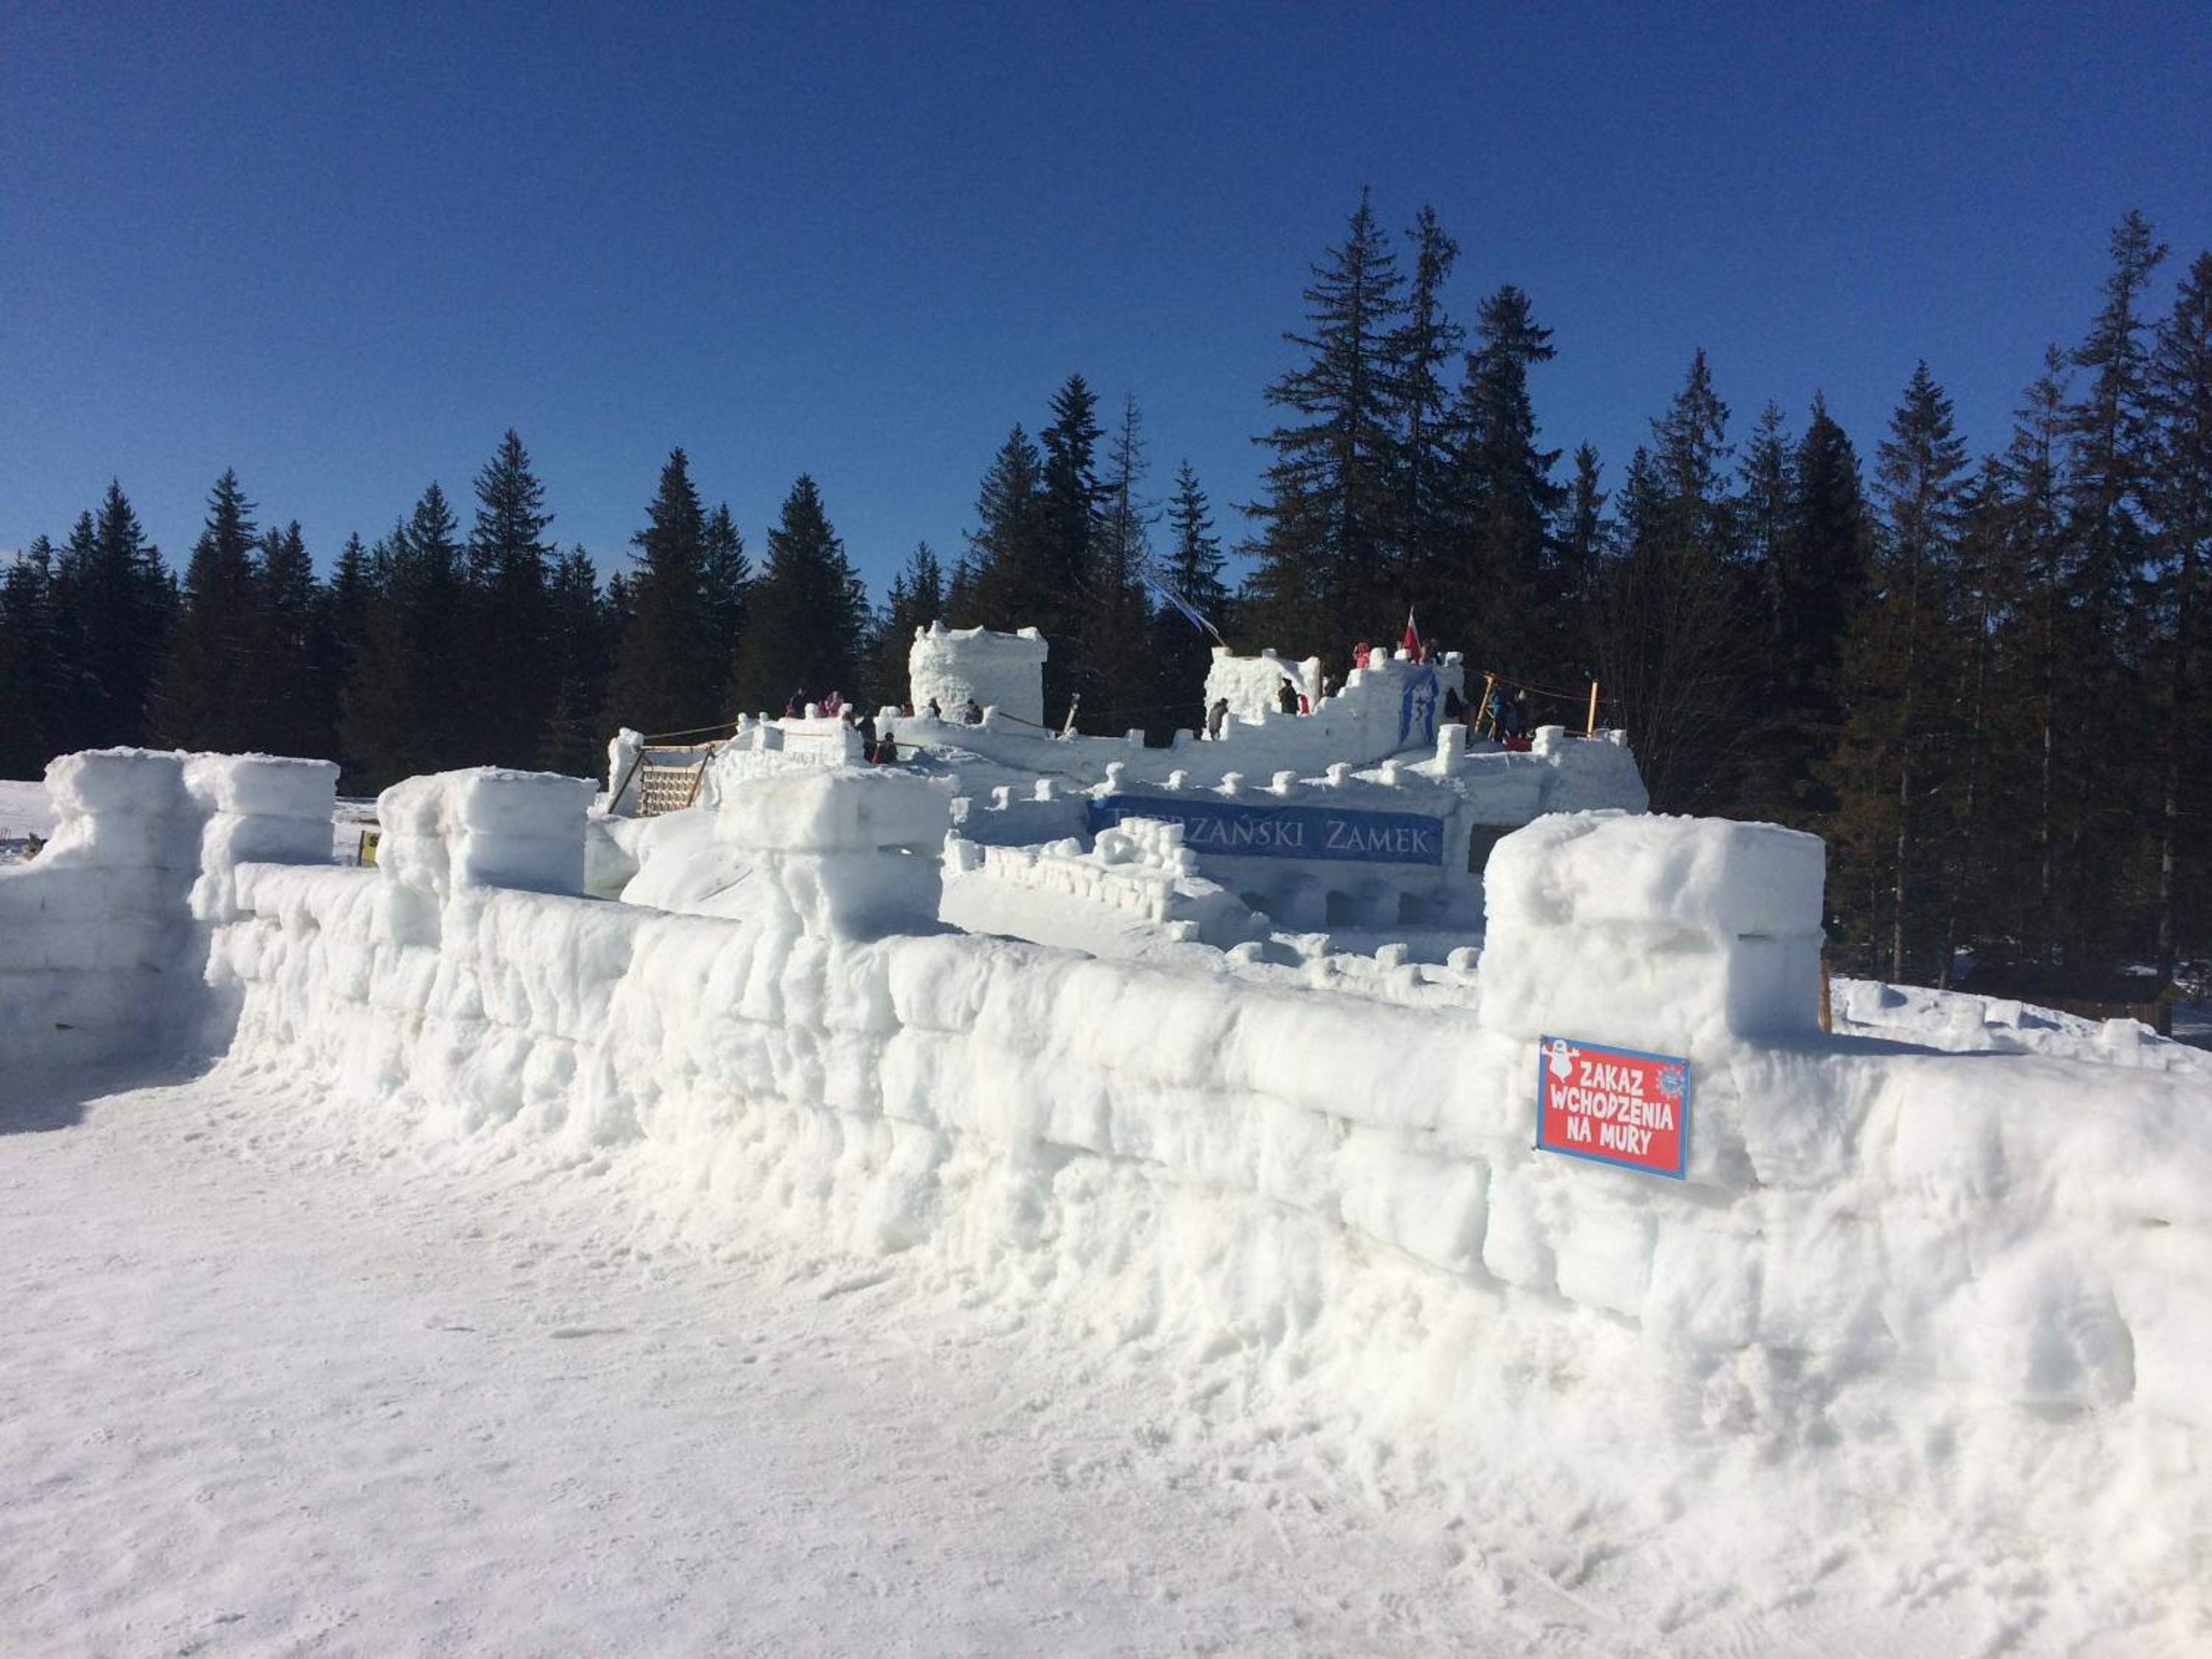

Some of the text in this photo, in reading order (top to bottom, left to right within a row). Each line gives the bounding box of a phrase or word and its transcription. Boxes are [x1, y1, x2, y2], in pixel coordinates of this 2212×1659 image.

[1326, 820, 1428, 853] ZAMEK
[1580, 1061, 1644, 1096] ZAKAZ
[1550, 1083, 1674, 1131] WCHODZENIA
[1567, 1116, 1652, 1156] NA MURY
